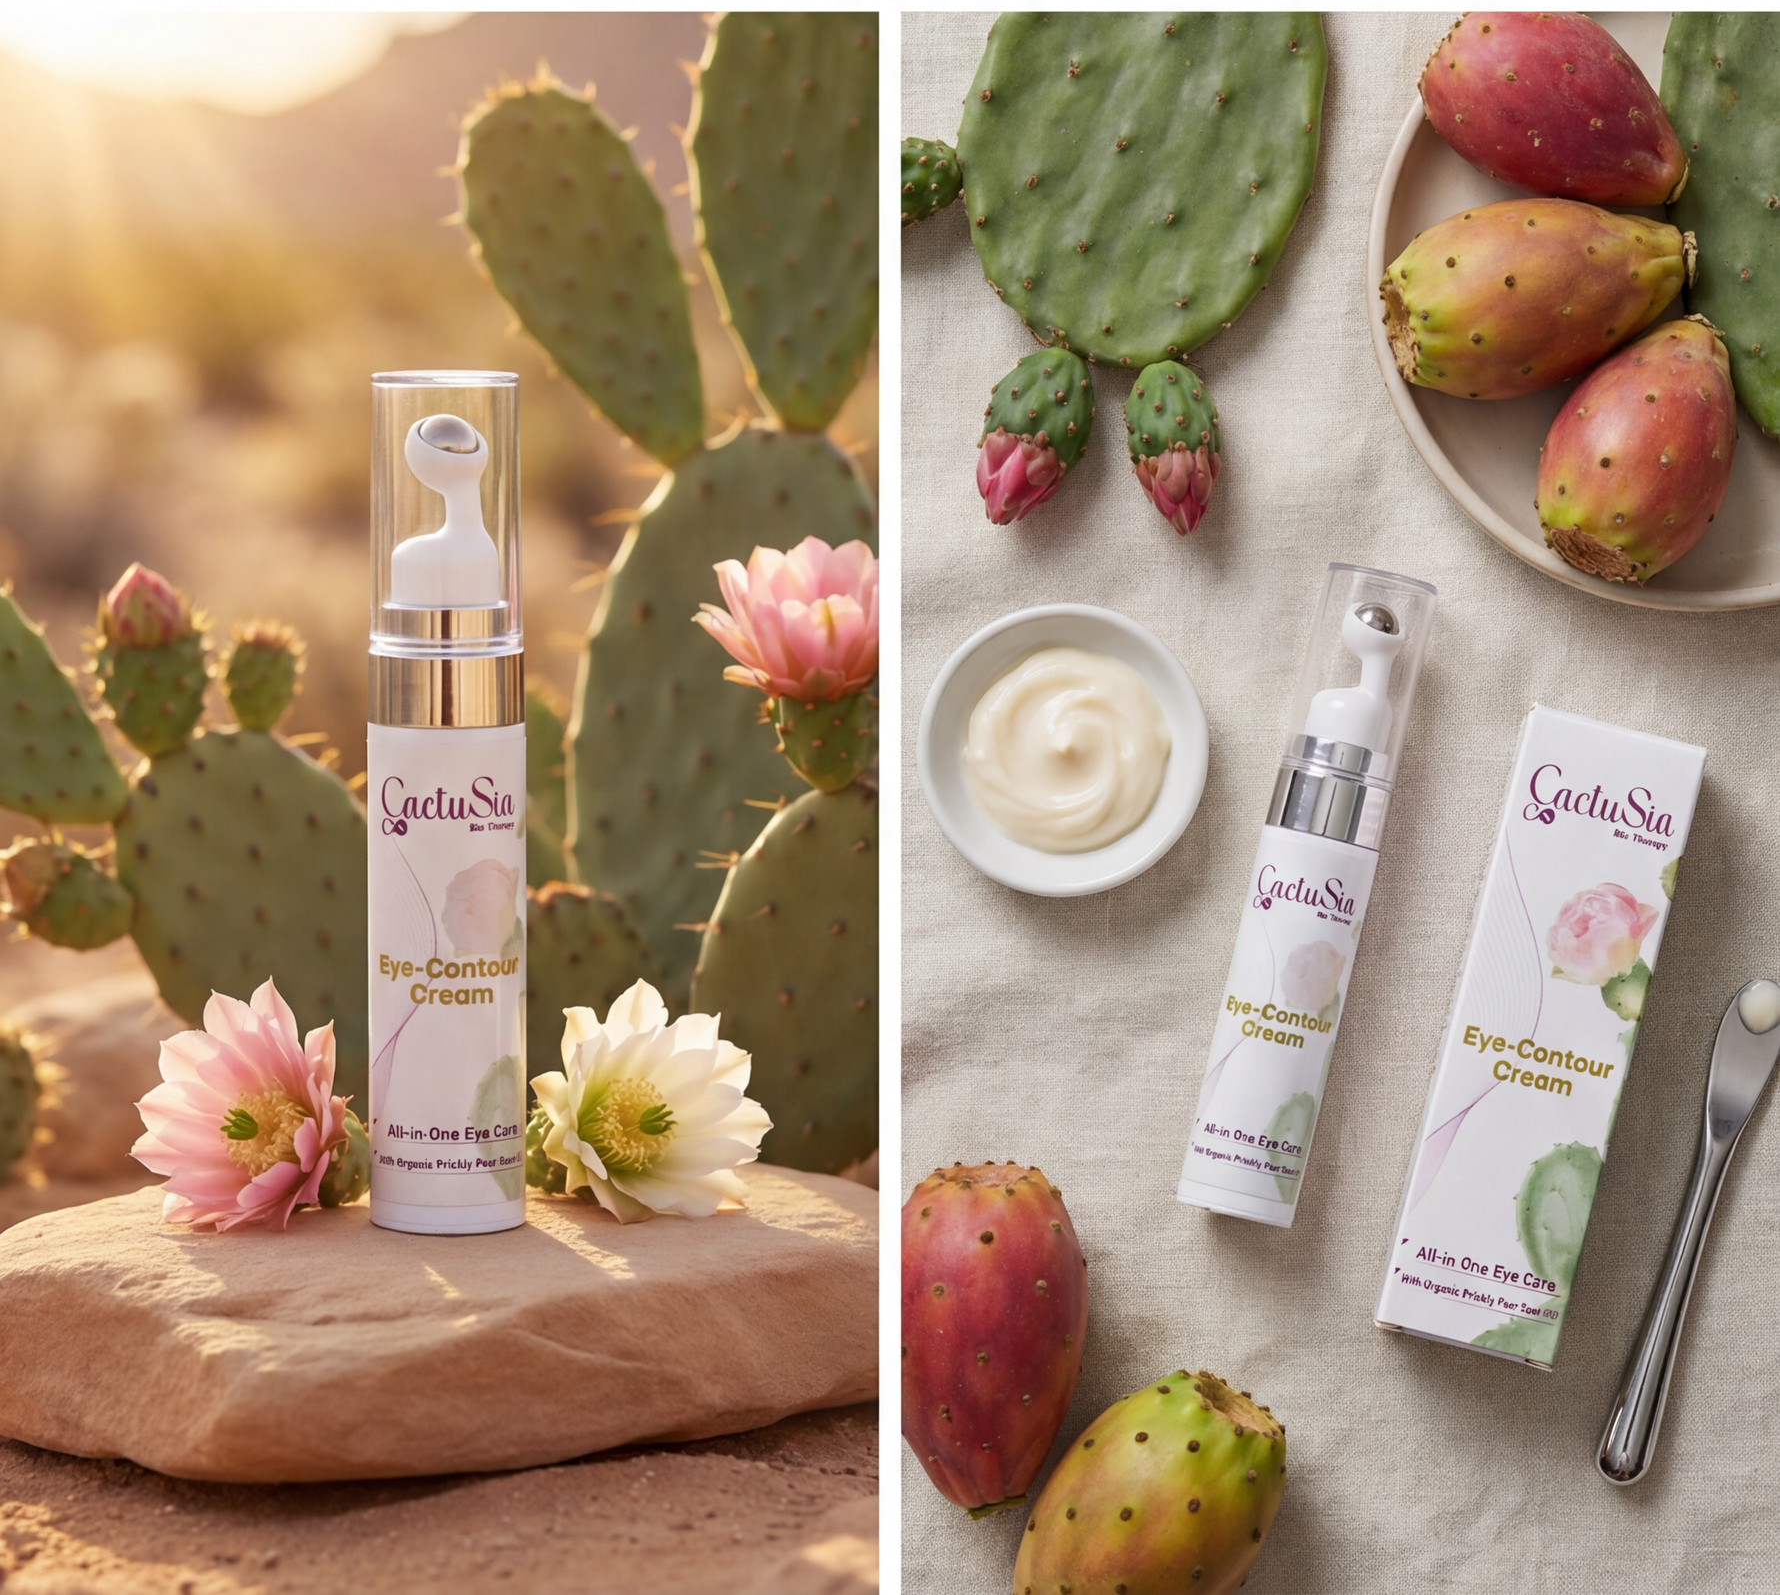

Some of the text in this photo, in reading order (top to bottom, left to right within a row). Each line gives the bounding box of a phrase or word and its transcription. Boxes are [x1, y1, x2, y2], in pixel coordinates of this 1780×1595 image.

[381, 776, 515, 820] CactuSia
[1529, 763, 1675, 837] CactuSia
[1258, 864, 1356, 916] CactuSia
[379, 954, 519, 982] Eye-Contour
[410, 983, 494, 1005] Cream
[1226, 995, 1332, 1034] Eye-Contour
[1241, 1020, 1305, 1049] Cream
[1463, 1024, 1615, 1079] Eye-Contour
[1493, 1060, 1573, 1097] Cream
[465, 1127, 490, 1143] Eye
[1281, 1140, 1302, 1155] Care
[1493, 1264, 1519, 1283] Eye
[1523, 1272, 1556, 1292] Care
